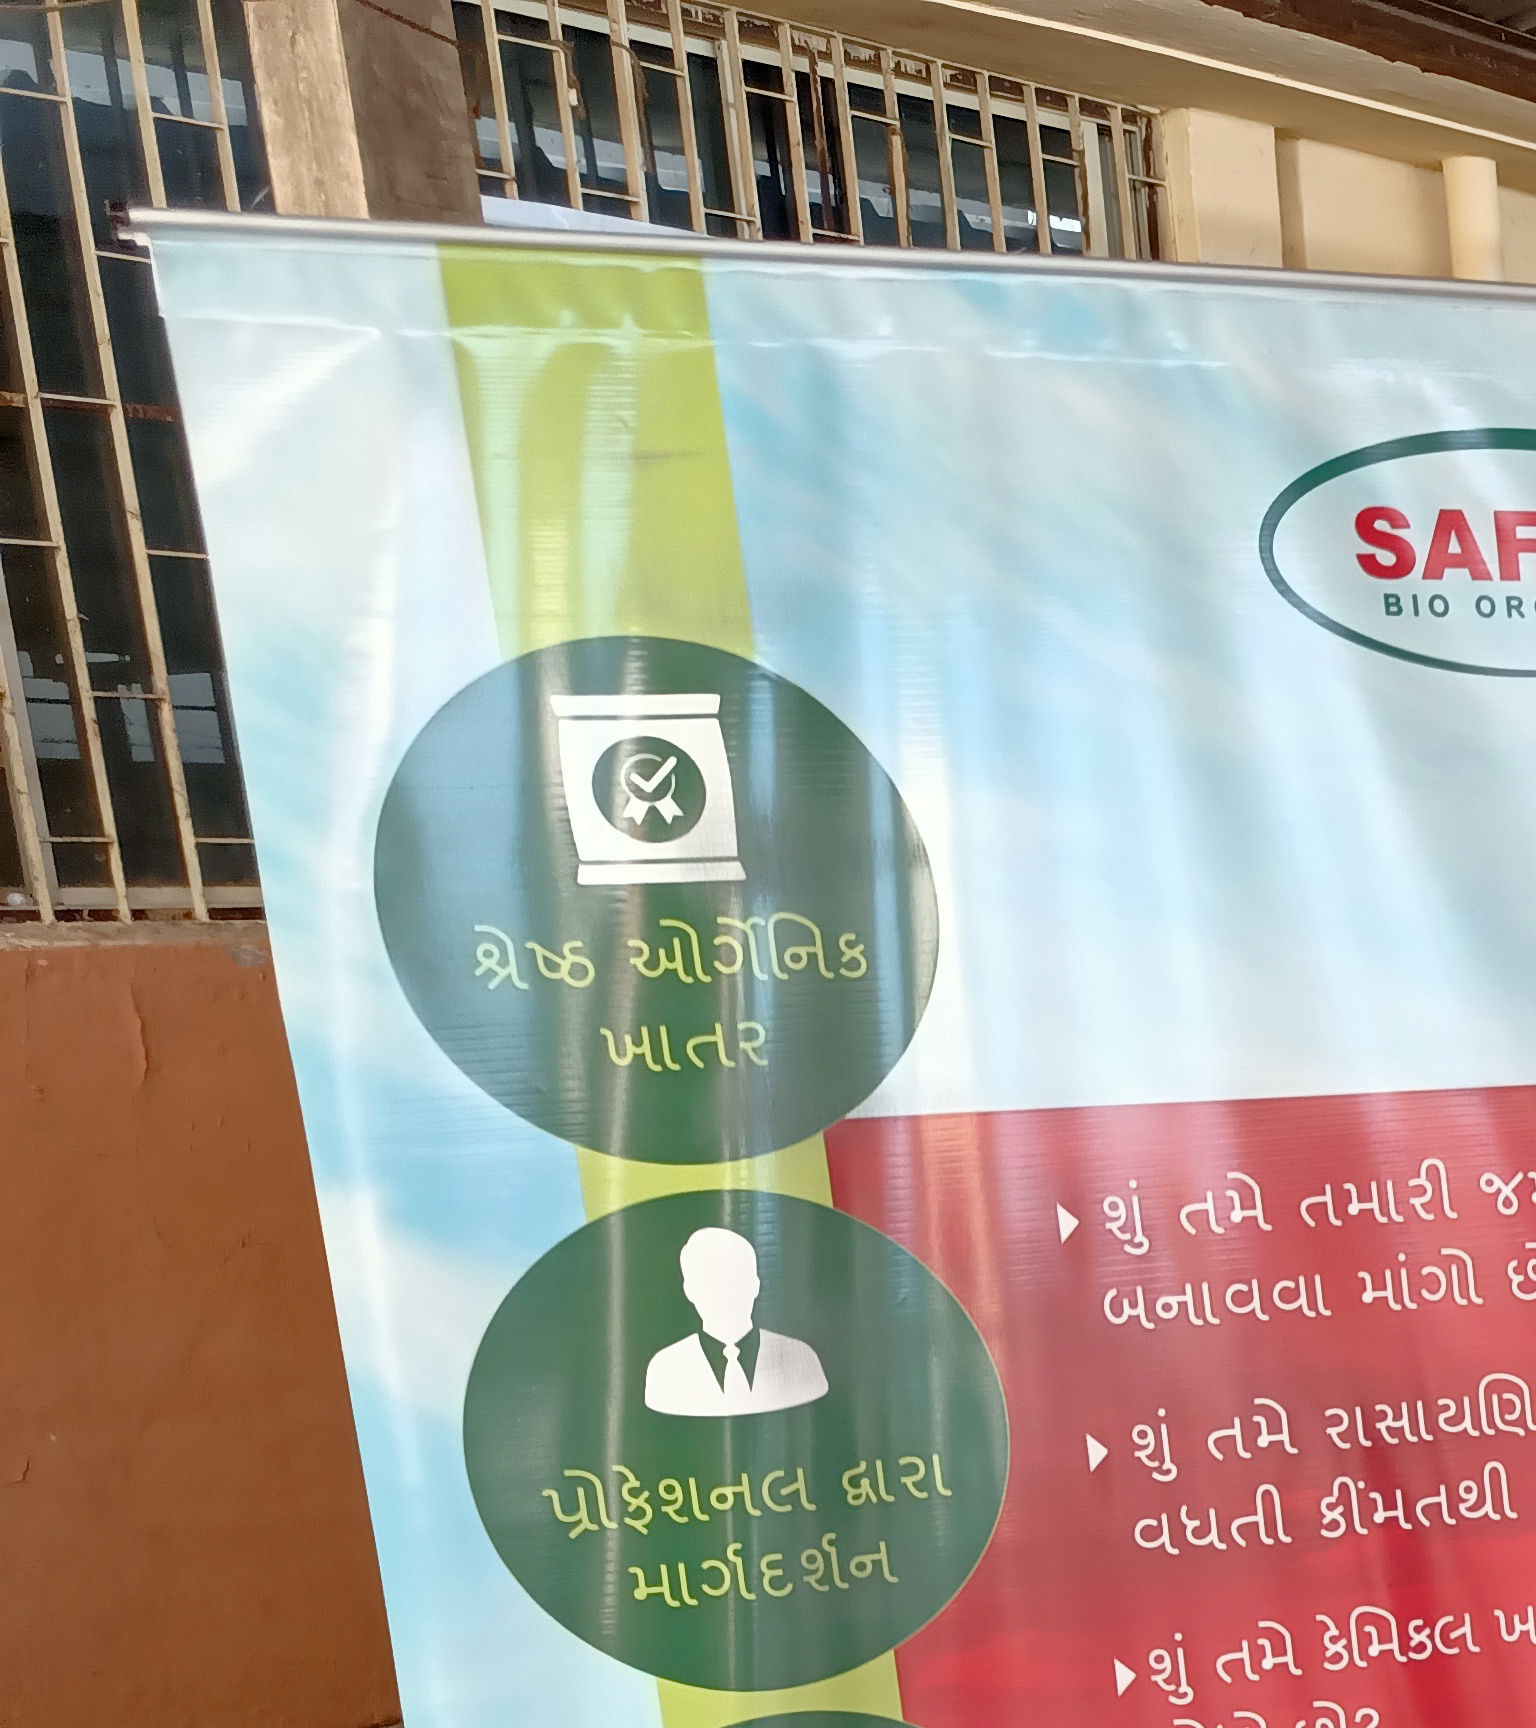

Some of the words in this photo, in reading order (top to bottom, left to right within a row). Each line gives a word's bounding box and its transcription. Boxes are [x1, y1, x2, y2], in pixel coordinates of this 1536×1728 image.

[1383, 592, 1450, 618] BIO
[474, 924, 597, 991] શ્રેષ્ઠ
[600, 1021, 770, 1072] ખાતર
[1101, 1178, 1151, 1256] શું
[1178, 1172, 1274, 1238] તમે
[1299, 1157, 1459, 1228] તમારી
[1102, 1272, 1332, 1332] બનાવવા
[1359, 1246, 1486, 1314] માંગો
[841, 1453, 953, 1506] દ્વારા
[1131, 1407, 1179, 1483] શું
[1205, 1397, 1299, 1463] તમે
[1133, 1482, 1293, 1557] વધતી
[1319, 1460, 1519, 1541] કીંમતથી
[628, 1532, 899, 1608] માર્ગદર્શન
[1148, 1631, 1195, 1706] શું
[1215, 1620, 1302, 1686] તમે
[1322, 1605, 1481, 1673] કેમિકલ
